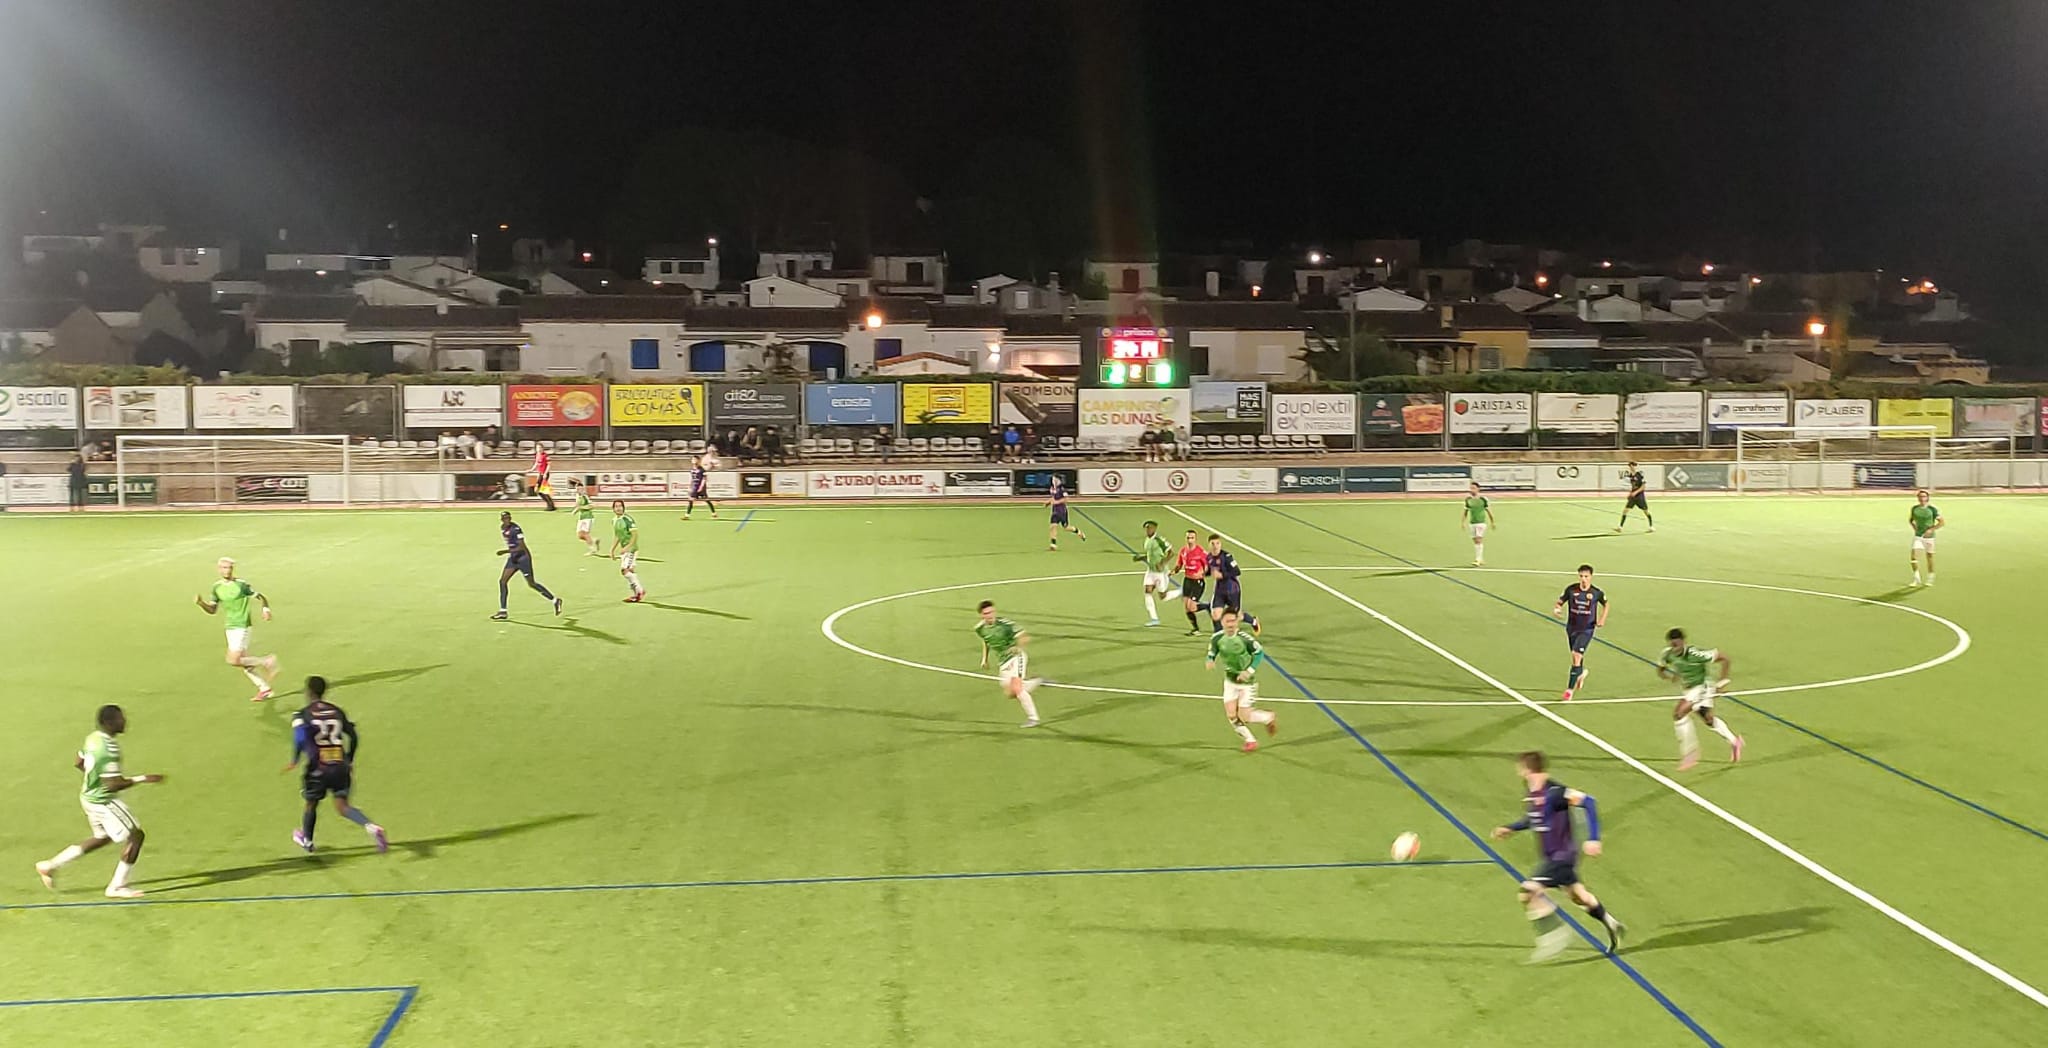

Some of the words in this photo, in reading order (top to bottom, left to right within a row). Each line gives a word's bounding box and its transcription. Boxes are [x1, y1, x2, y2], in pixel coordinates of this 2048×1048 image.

[17, 391, 68, 406] escala
[1470, 400, 1513, 411] ARISTA
[1516, 400, 1528, 410] SL
[624, 402, 689, 416] COMAS
[1276, 400, 1351, 416] duplextil
[1082, 414, 1109, 425] LAS
[1111, 413, 1164, 425] DUNAS
[1277, 416, 1299, 430] ex
[834, 475, 874, 486] EURO
[877, 474, 924, 486] GAME
[1300, 476, 1341, 486] BOSCH
[310, 718, 344, 746] 22
